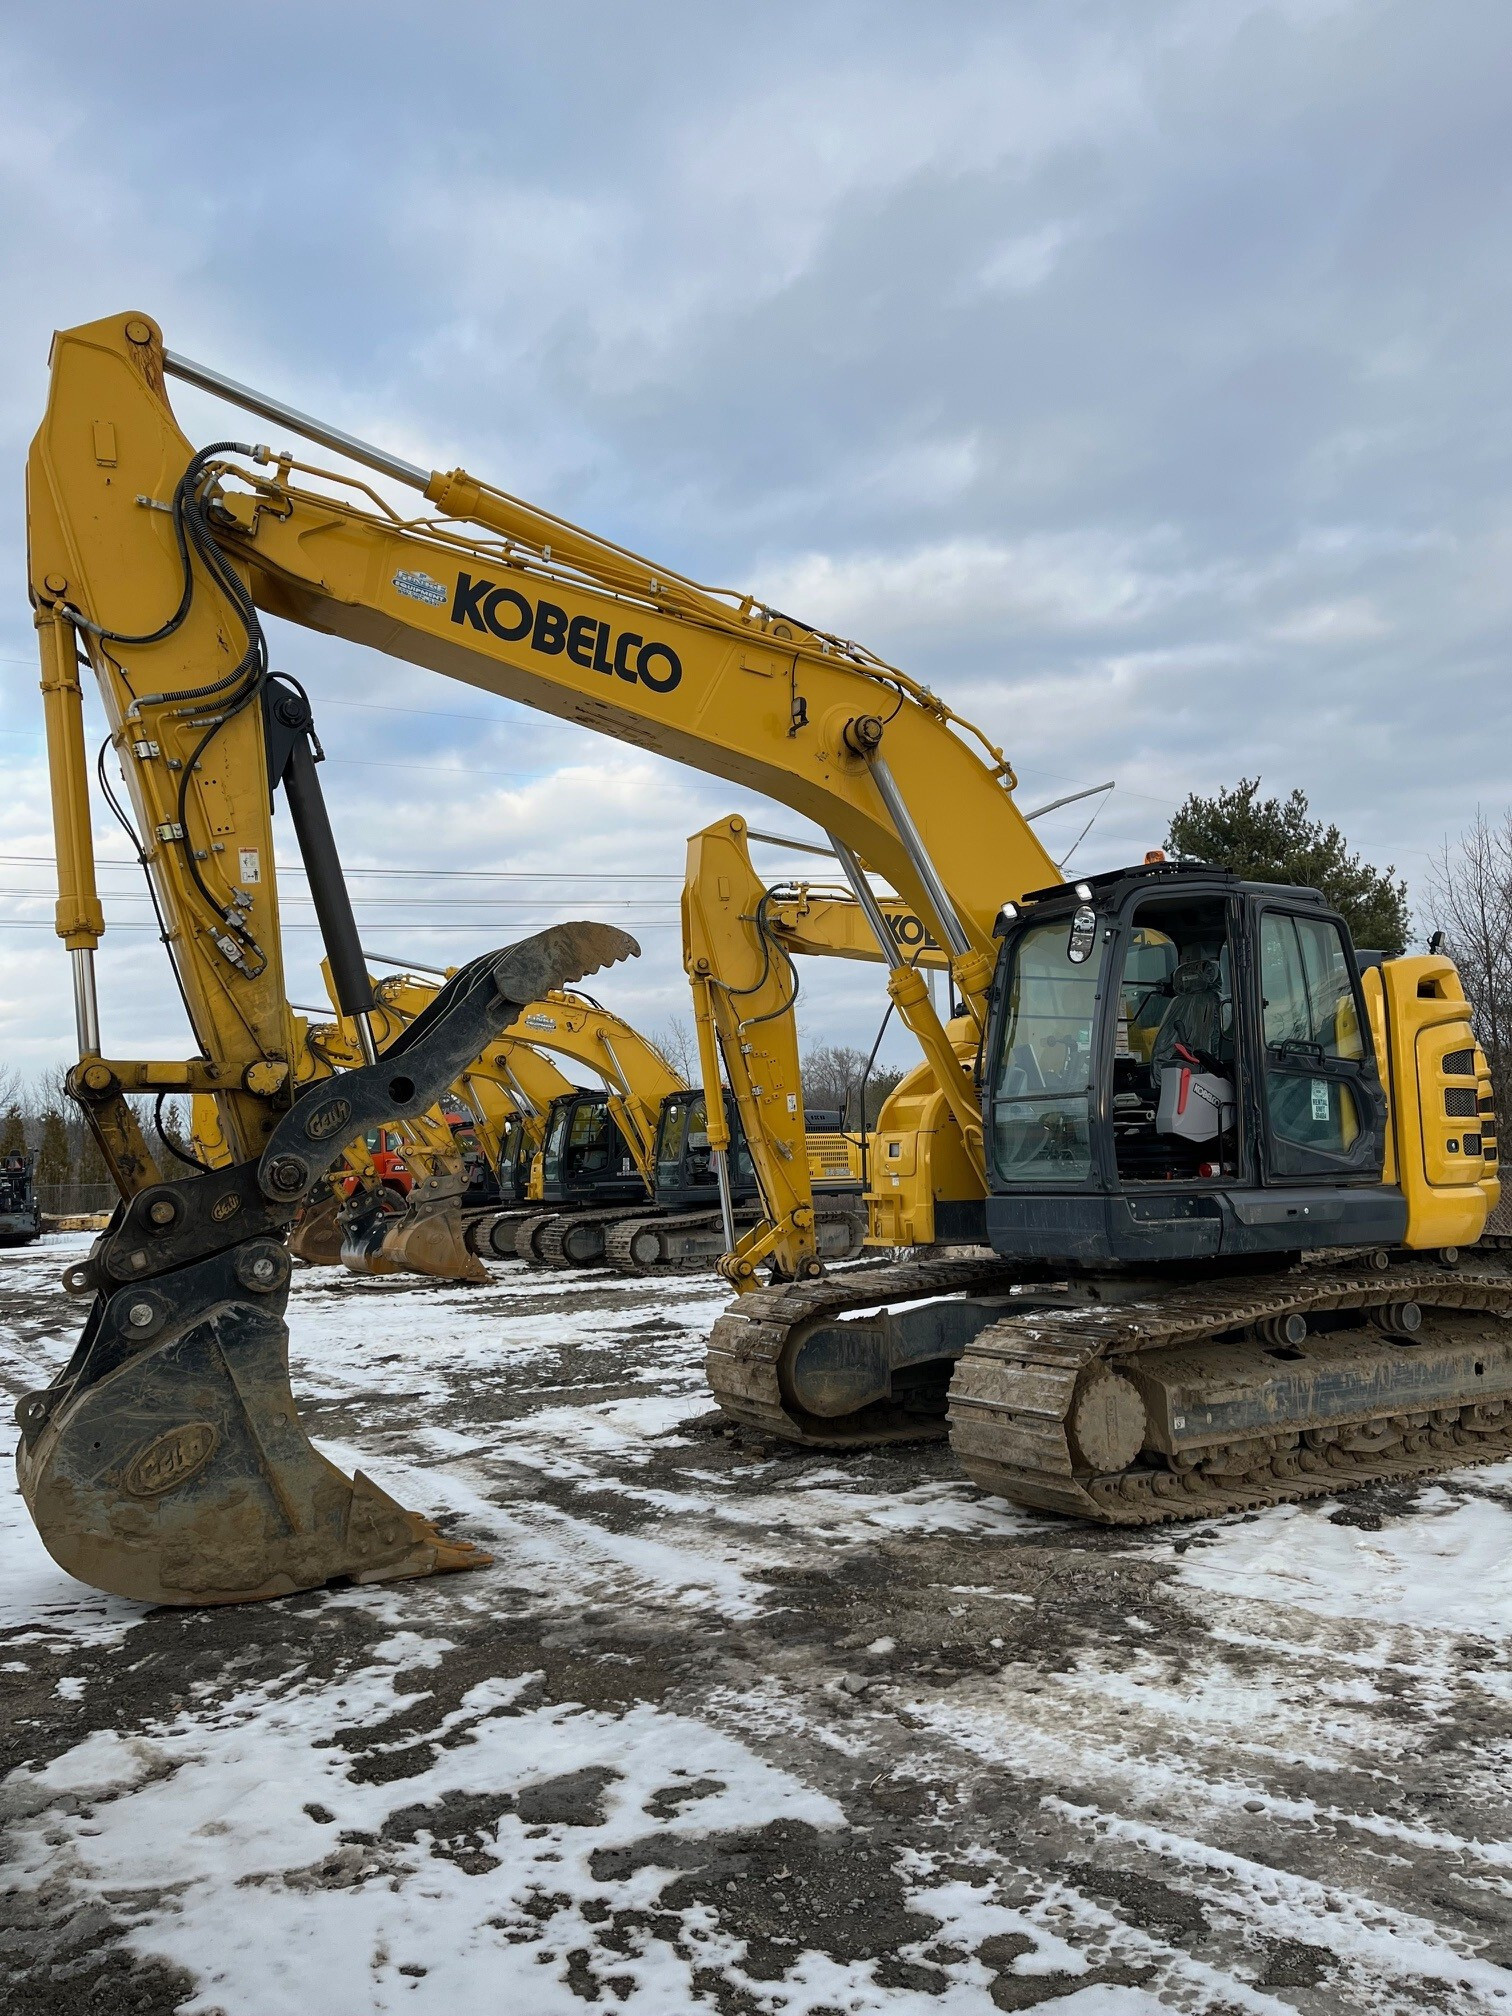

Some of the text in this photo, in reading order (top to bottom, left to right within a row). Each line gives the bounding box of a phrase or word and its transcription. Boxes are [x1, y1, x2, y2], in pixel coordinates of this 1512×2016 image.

[394, 580, 445, 601] EQUIPMENT
[451, 571, 682, 693] KOBELCO
[1194, 1083, 1220, 1107] KOBELCO
